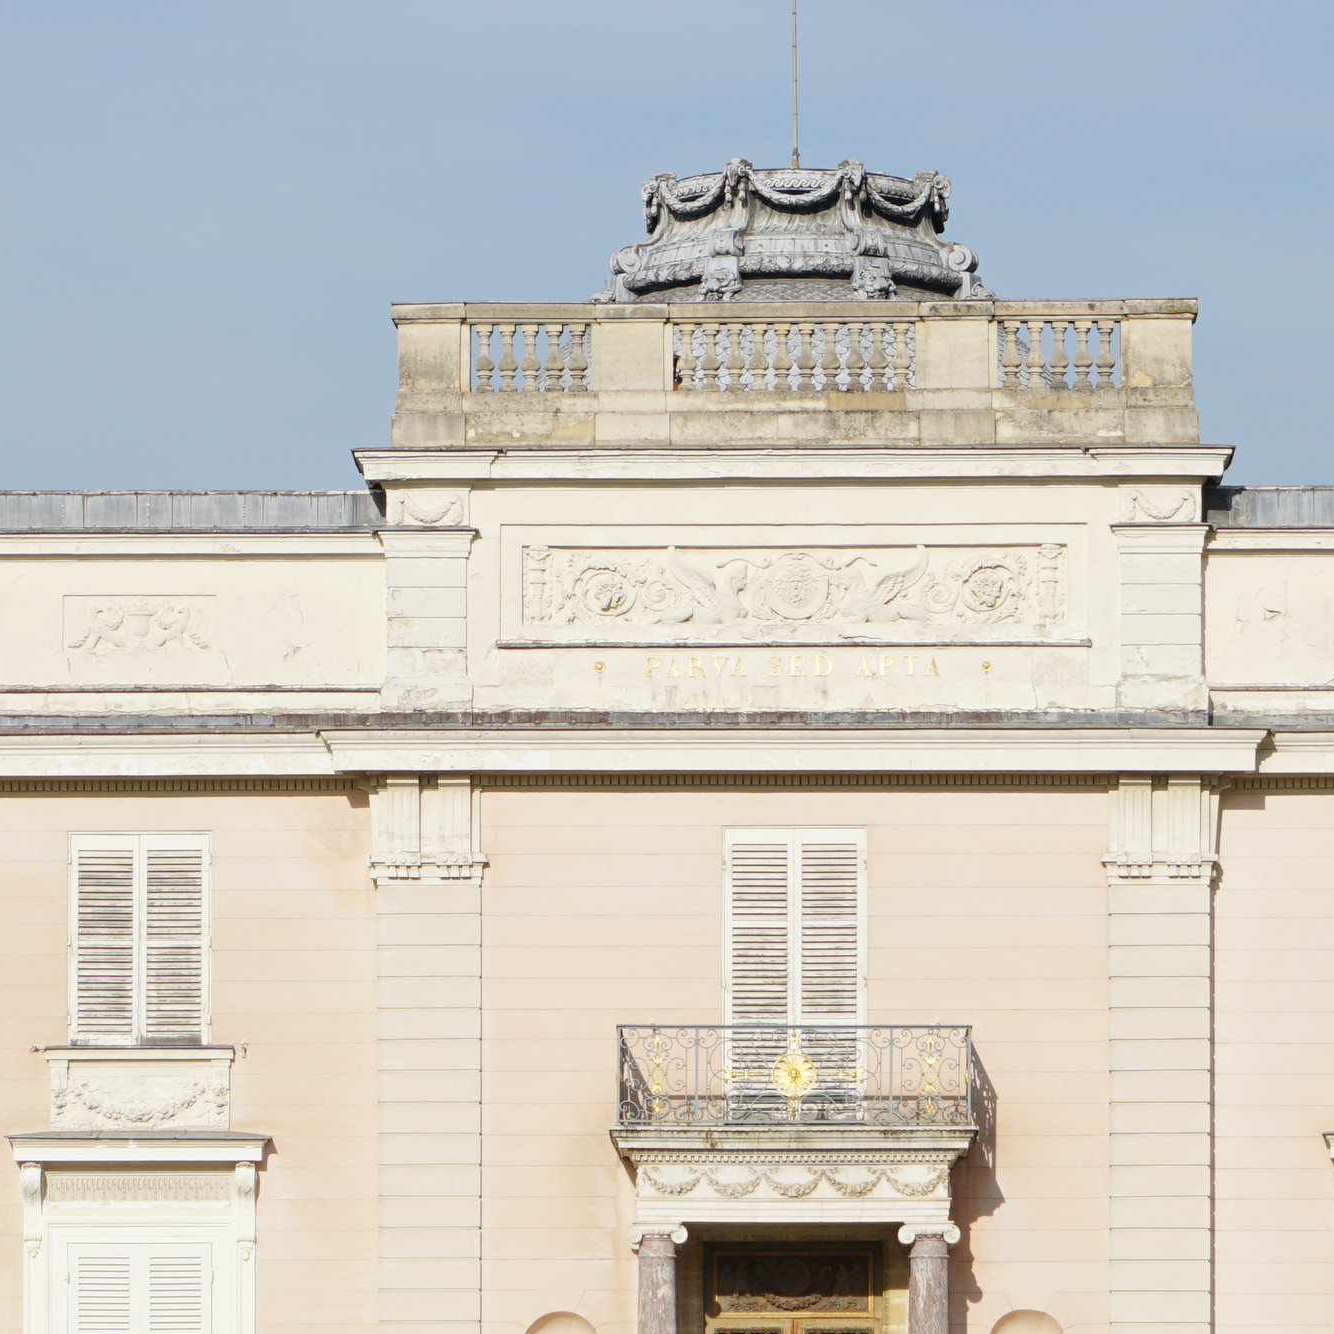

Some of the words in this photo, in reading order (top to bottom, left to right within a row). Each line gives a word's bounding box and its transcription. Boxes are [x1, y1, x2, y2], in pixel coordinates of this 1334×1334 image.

[645, 655, 747, 678] PARVA
[767, 655, 834, 678] SED
[855, 655, 942, 678] APTA
